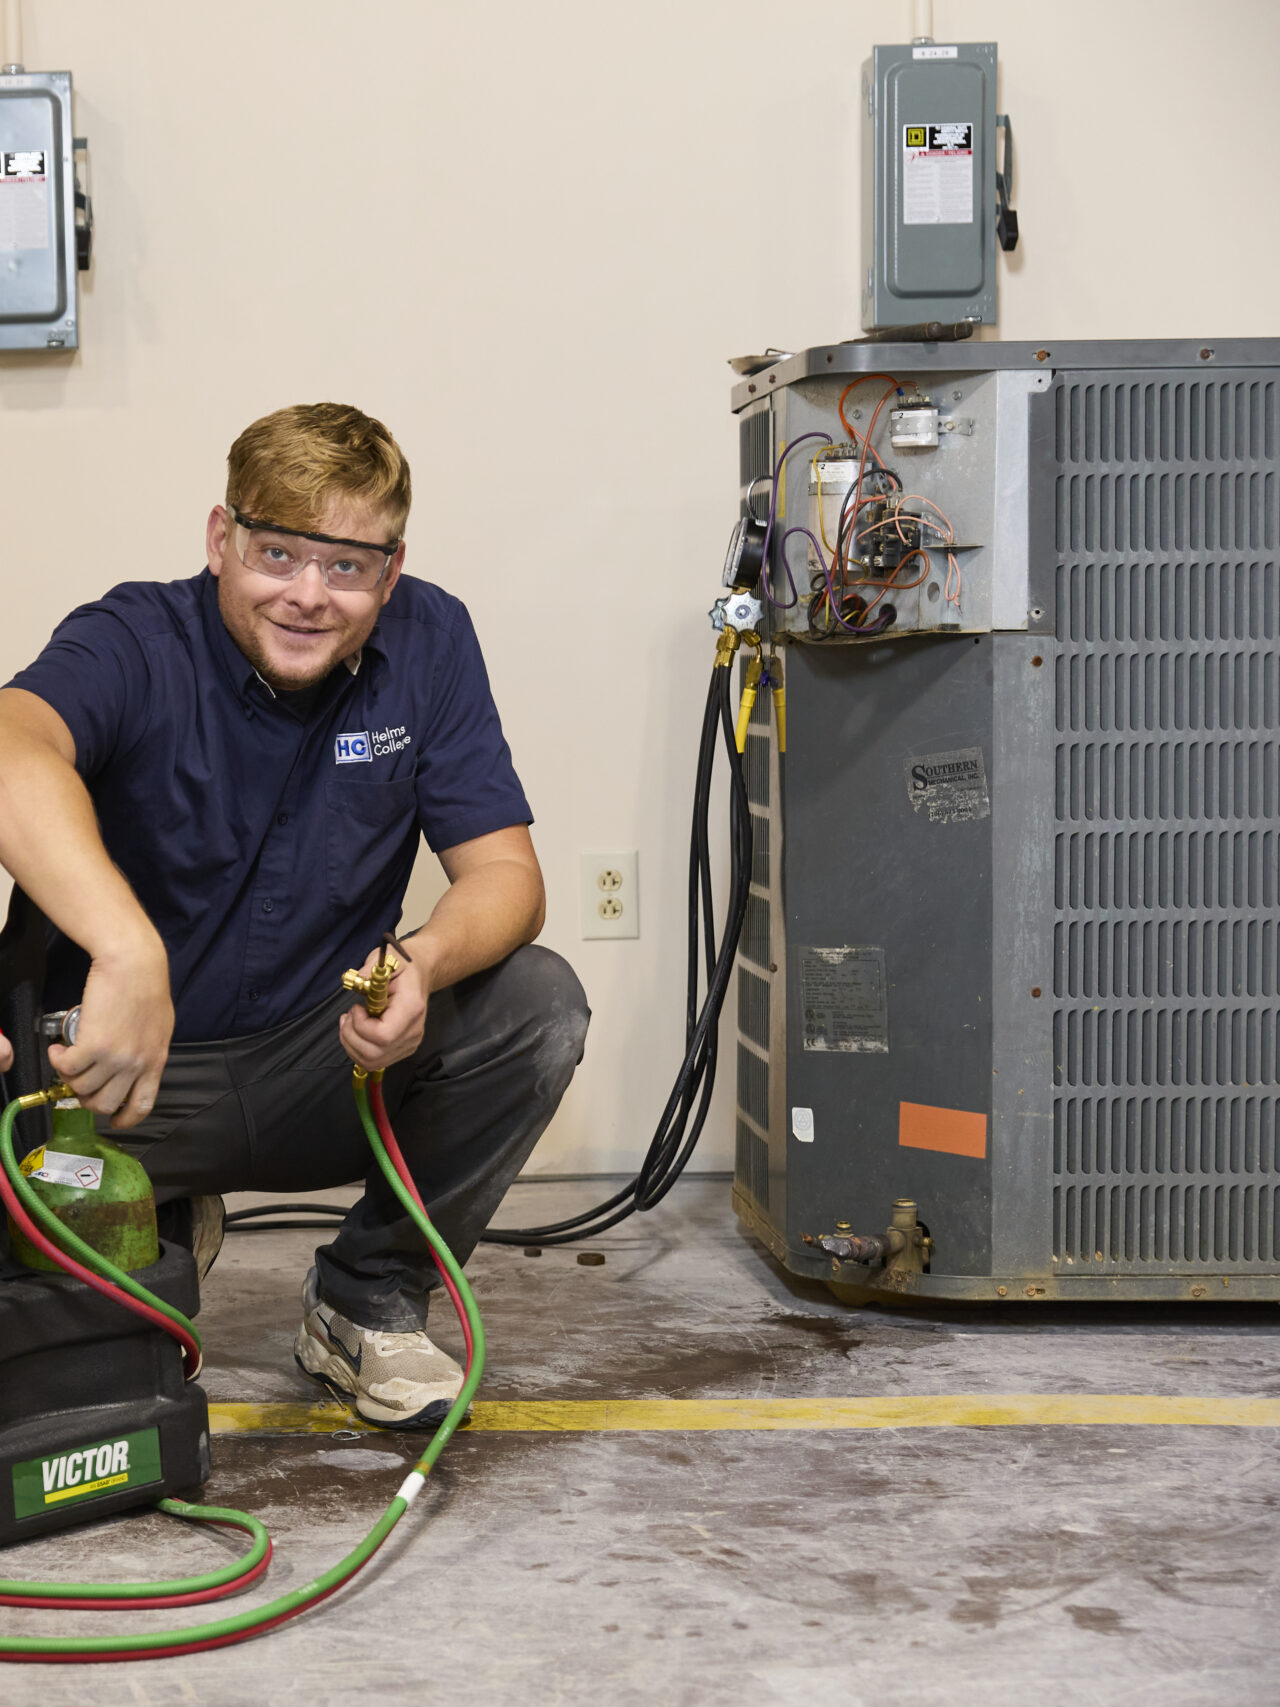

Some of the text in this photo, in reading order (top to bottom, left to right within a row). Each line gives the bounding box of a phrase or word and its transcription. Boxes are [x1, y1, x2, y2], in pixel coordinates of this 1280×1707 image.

[371, 726, 406, 744] Helms
[337, 738, 367, 757] HC
[42, 1440, 129, 1492] VICTOR
